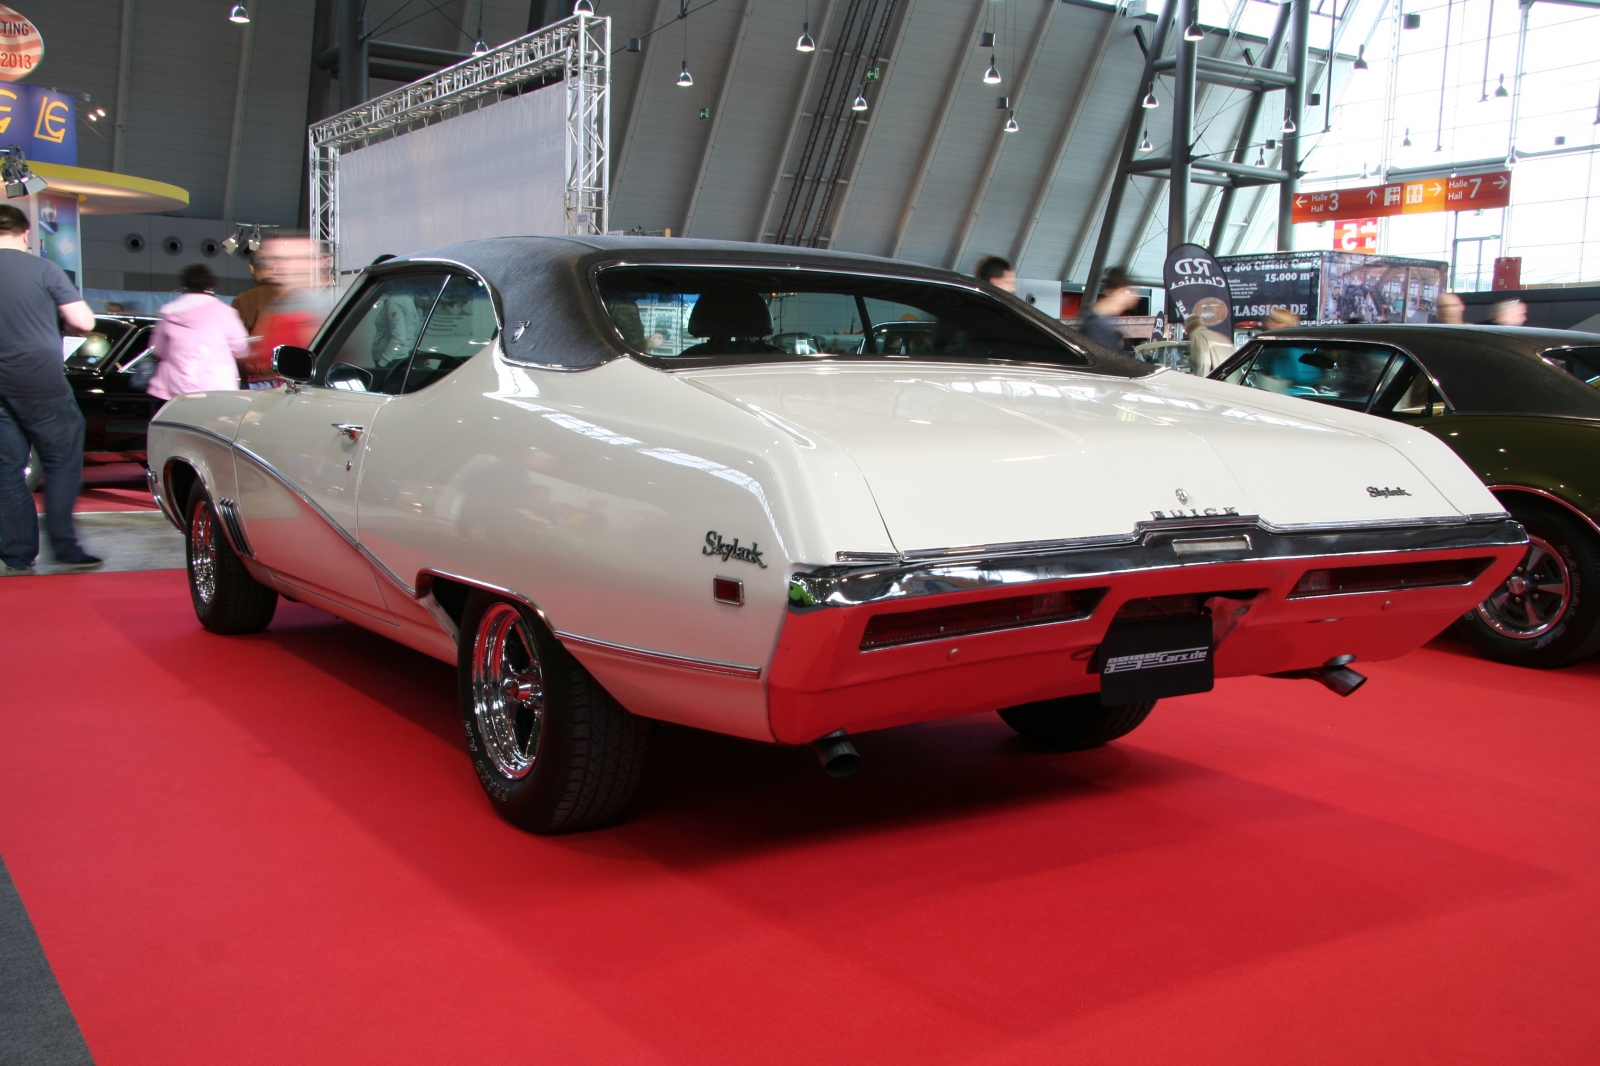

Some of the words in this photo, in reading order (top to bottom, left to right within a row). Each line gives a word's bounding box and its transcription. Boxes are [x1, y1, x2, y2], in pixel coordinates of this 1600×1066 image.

[0, 21, 29, 37] TING
[1, 52, 32, 70] 2013
[1449, 180, 1468, 189] Halle
[1469, 178, 1482, 199] 7
[1311, 194, 1328, 202] Halle
[1328, 192, 1339, 212] 3
[1448, 191, 1463, 201] Hall
[1310, 204, 1324, 213] Hall
[1234, 263, 1252, 273] 400
[1254, 260, 1289, 271] Classic
[1264, 272, 1298, 283] 15.000
[1233, 304, 1287, 317] LASSICS
[1289, 303, 1308, 316] DE
[1366, 486, 1413, 499] Skylark
[702, 530, 768, 569] Skylark
